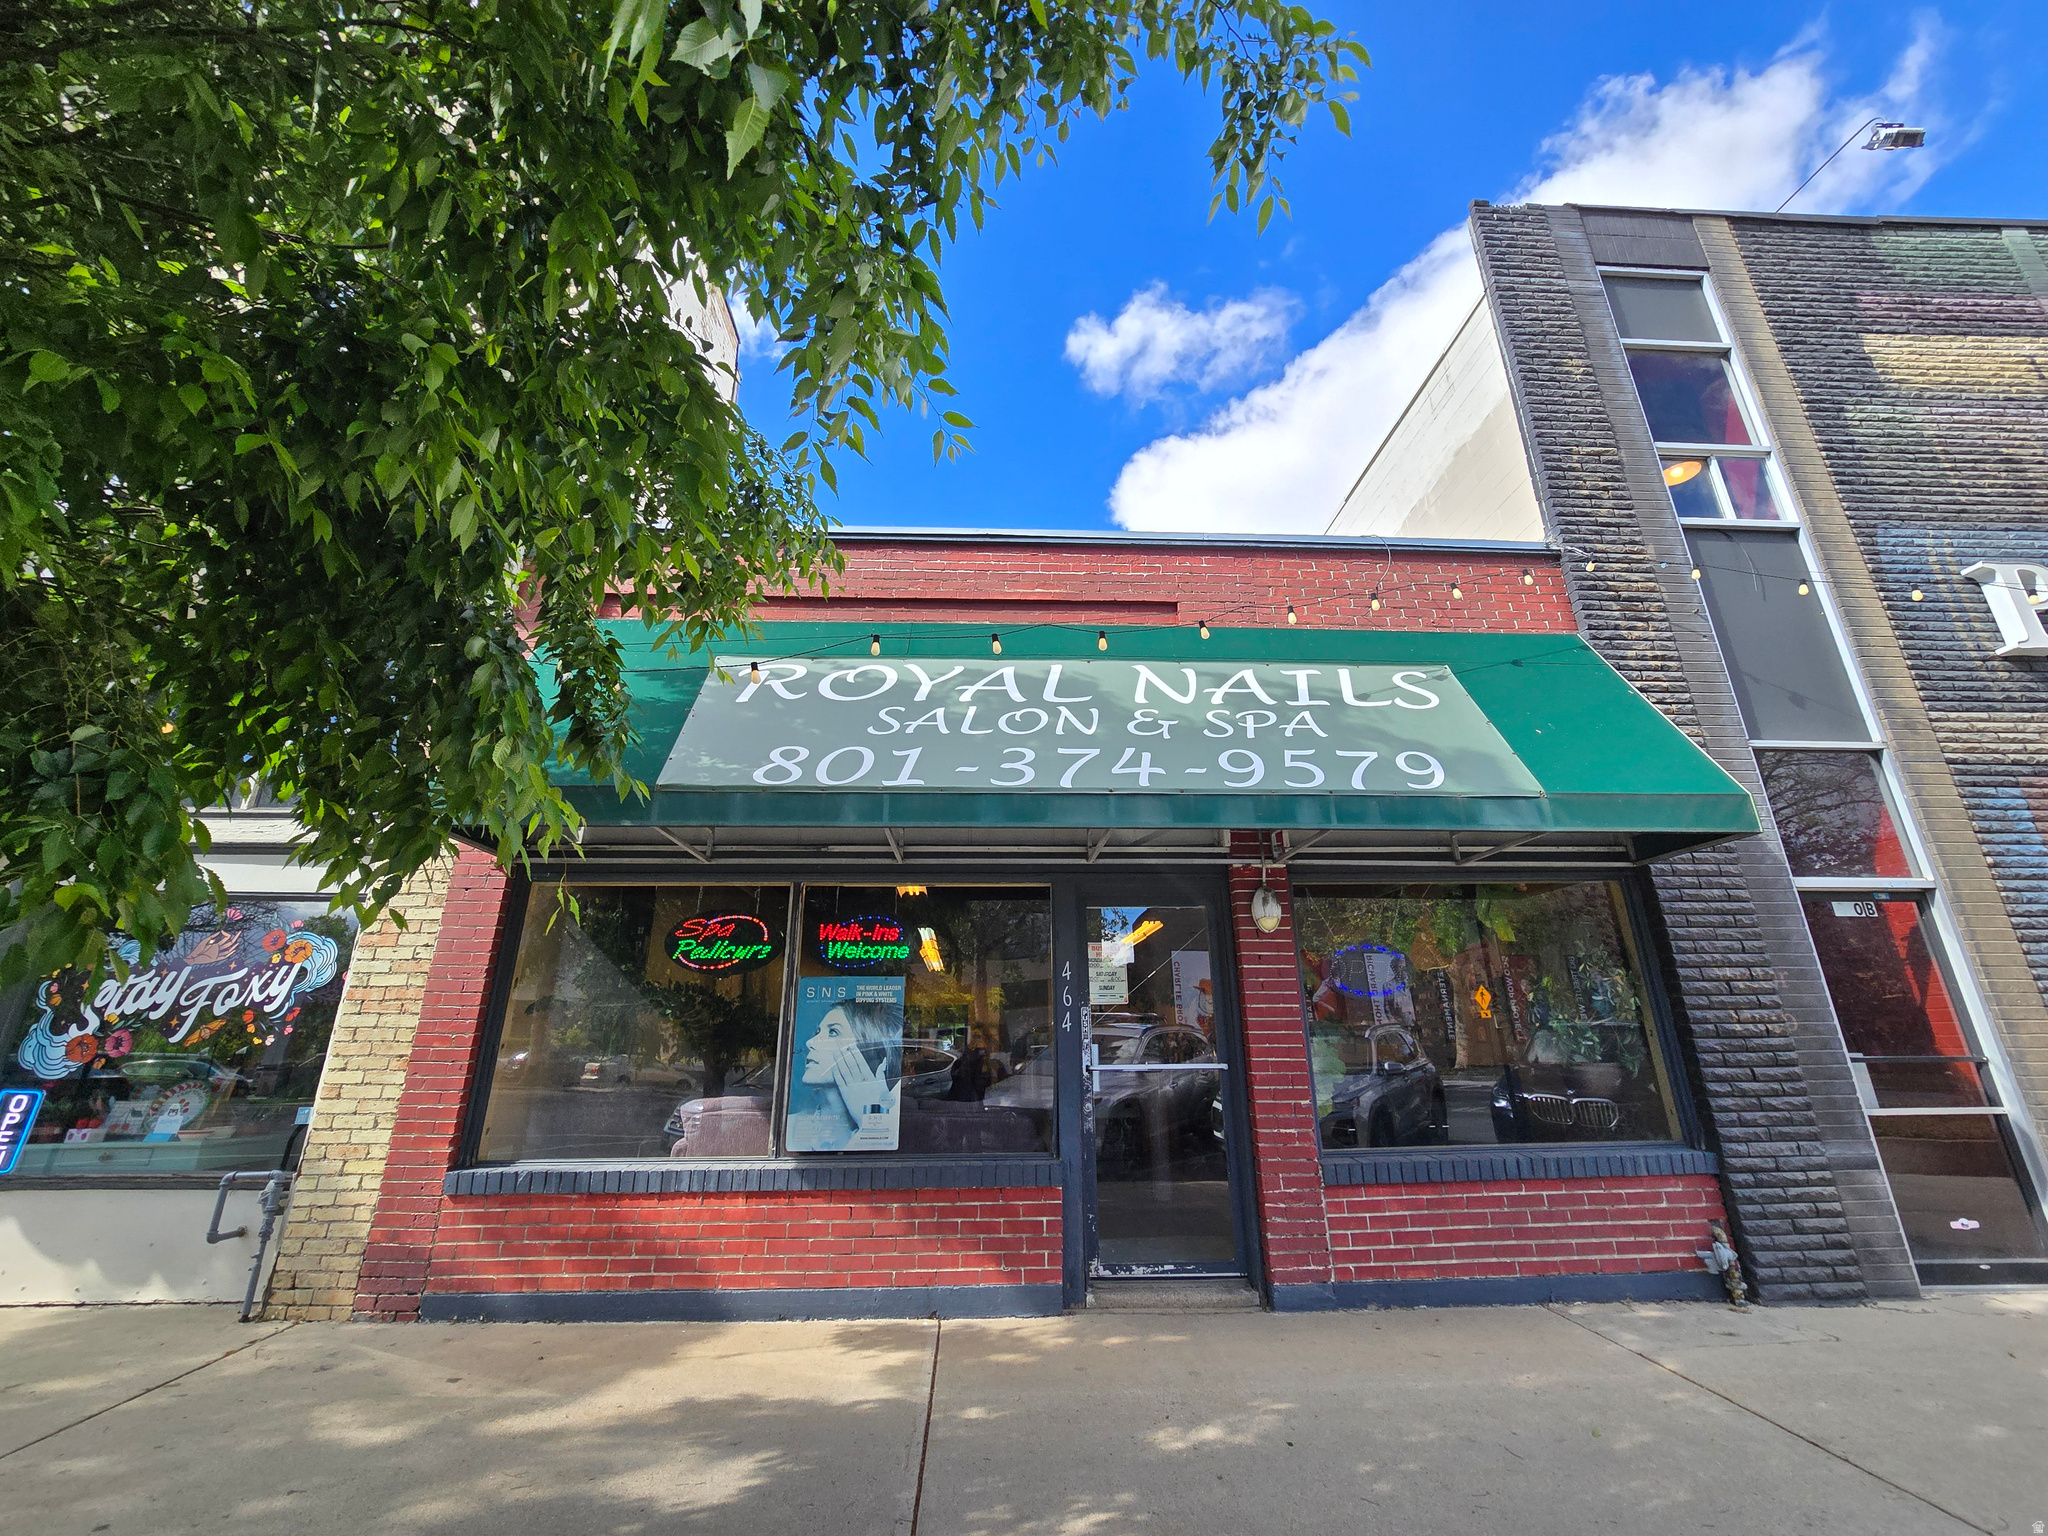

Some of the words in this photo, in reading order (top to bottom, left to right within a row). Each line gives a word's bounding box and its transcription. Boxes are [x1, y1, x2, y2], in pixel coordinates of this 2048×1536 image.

[736, 662, 1093, 704] ROYAL
[1135, 664, 1440, 711] NAILS
[866, 706, 1100, 737] SALON
[1126, 709, 1179, 740] &
[1202, 709, 1330, 740] SPA
[751, 745, 1447, 791] 801-374-9579
[674, 918, 736, 943] Spa
[819, 923, 900, 942] Walk-Ins
[672, 939, 773, 960] Pedicure
[827, 941, 911, 960] Welcome
[167, 963, 300, 1044] Foxy
[1062, 960, 1072, 1032] 464
